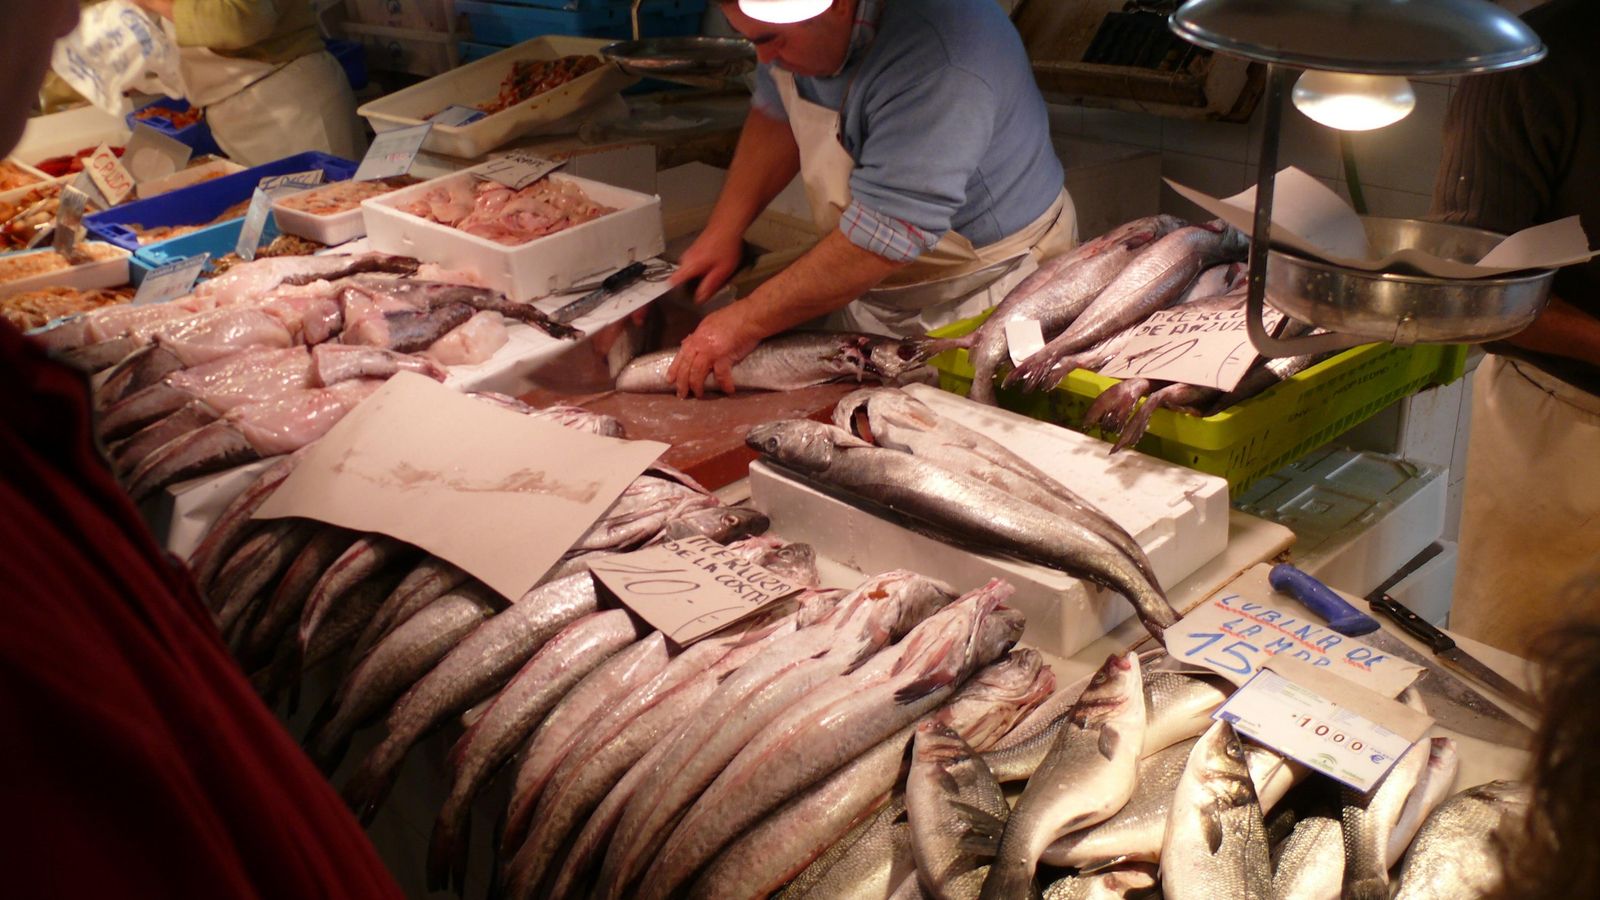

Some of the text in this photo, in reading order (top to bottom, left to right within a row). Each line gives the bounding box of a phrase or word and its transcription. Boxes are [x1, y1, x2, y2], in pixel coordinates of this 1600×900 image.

[1135, 324, 1167, 336] DE
[662, 542, 770, 606] DE LA COSTA
[1221, 594, 1391, 669] LUBINA DE
[1222, 618, 1263, 637] LA
[1185, 633, 1260, 675] 15
